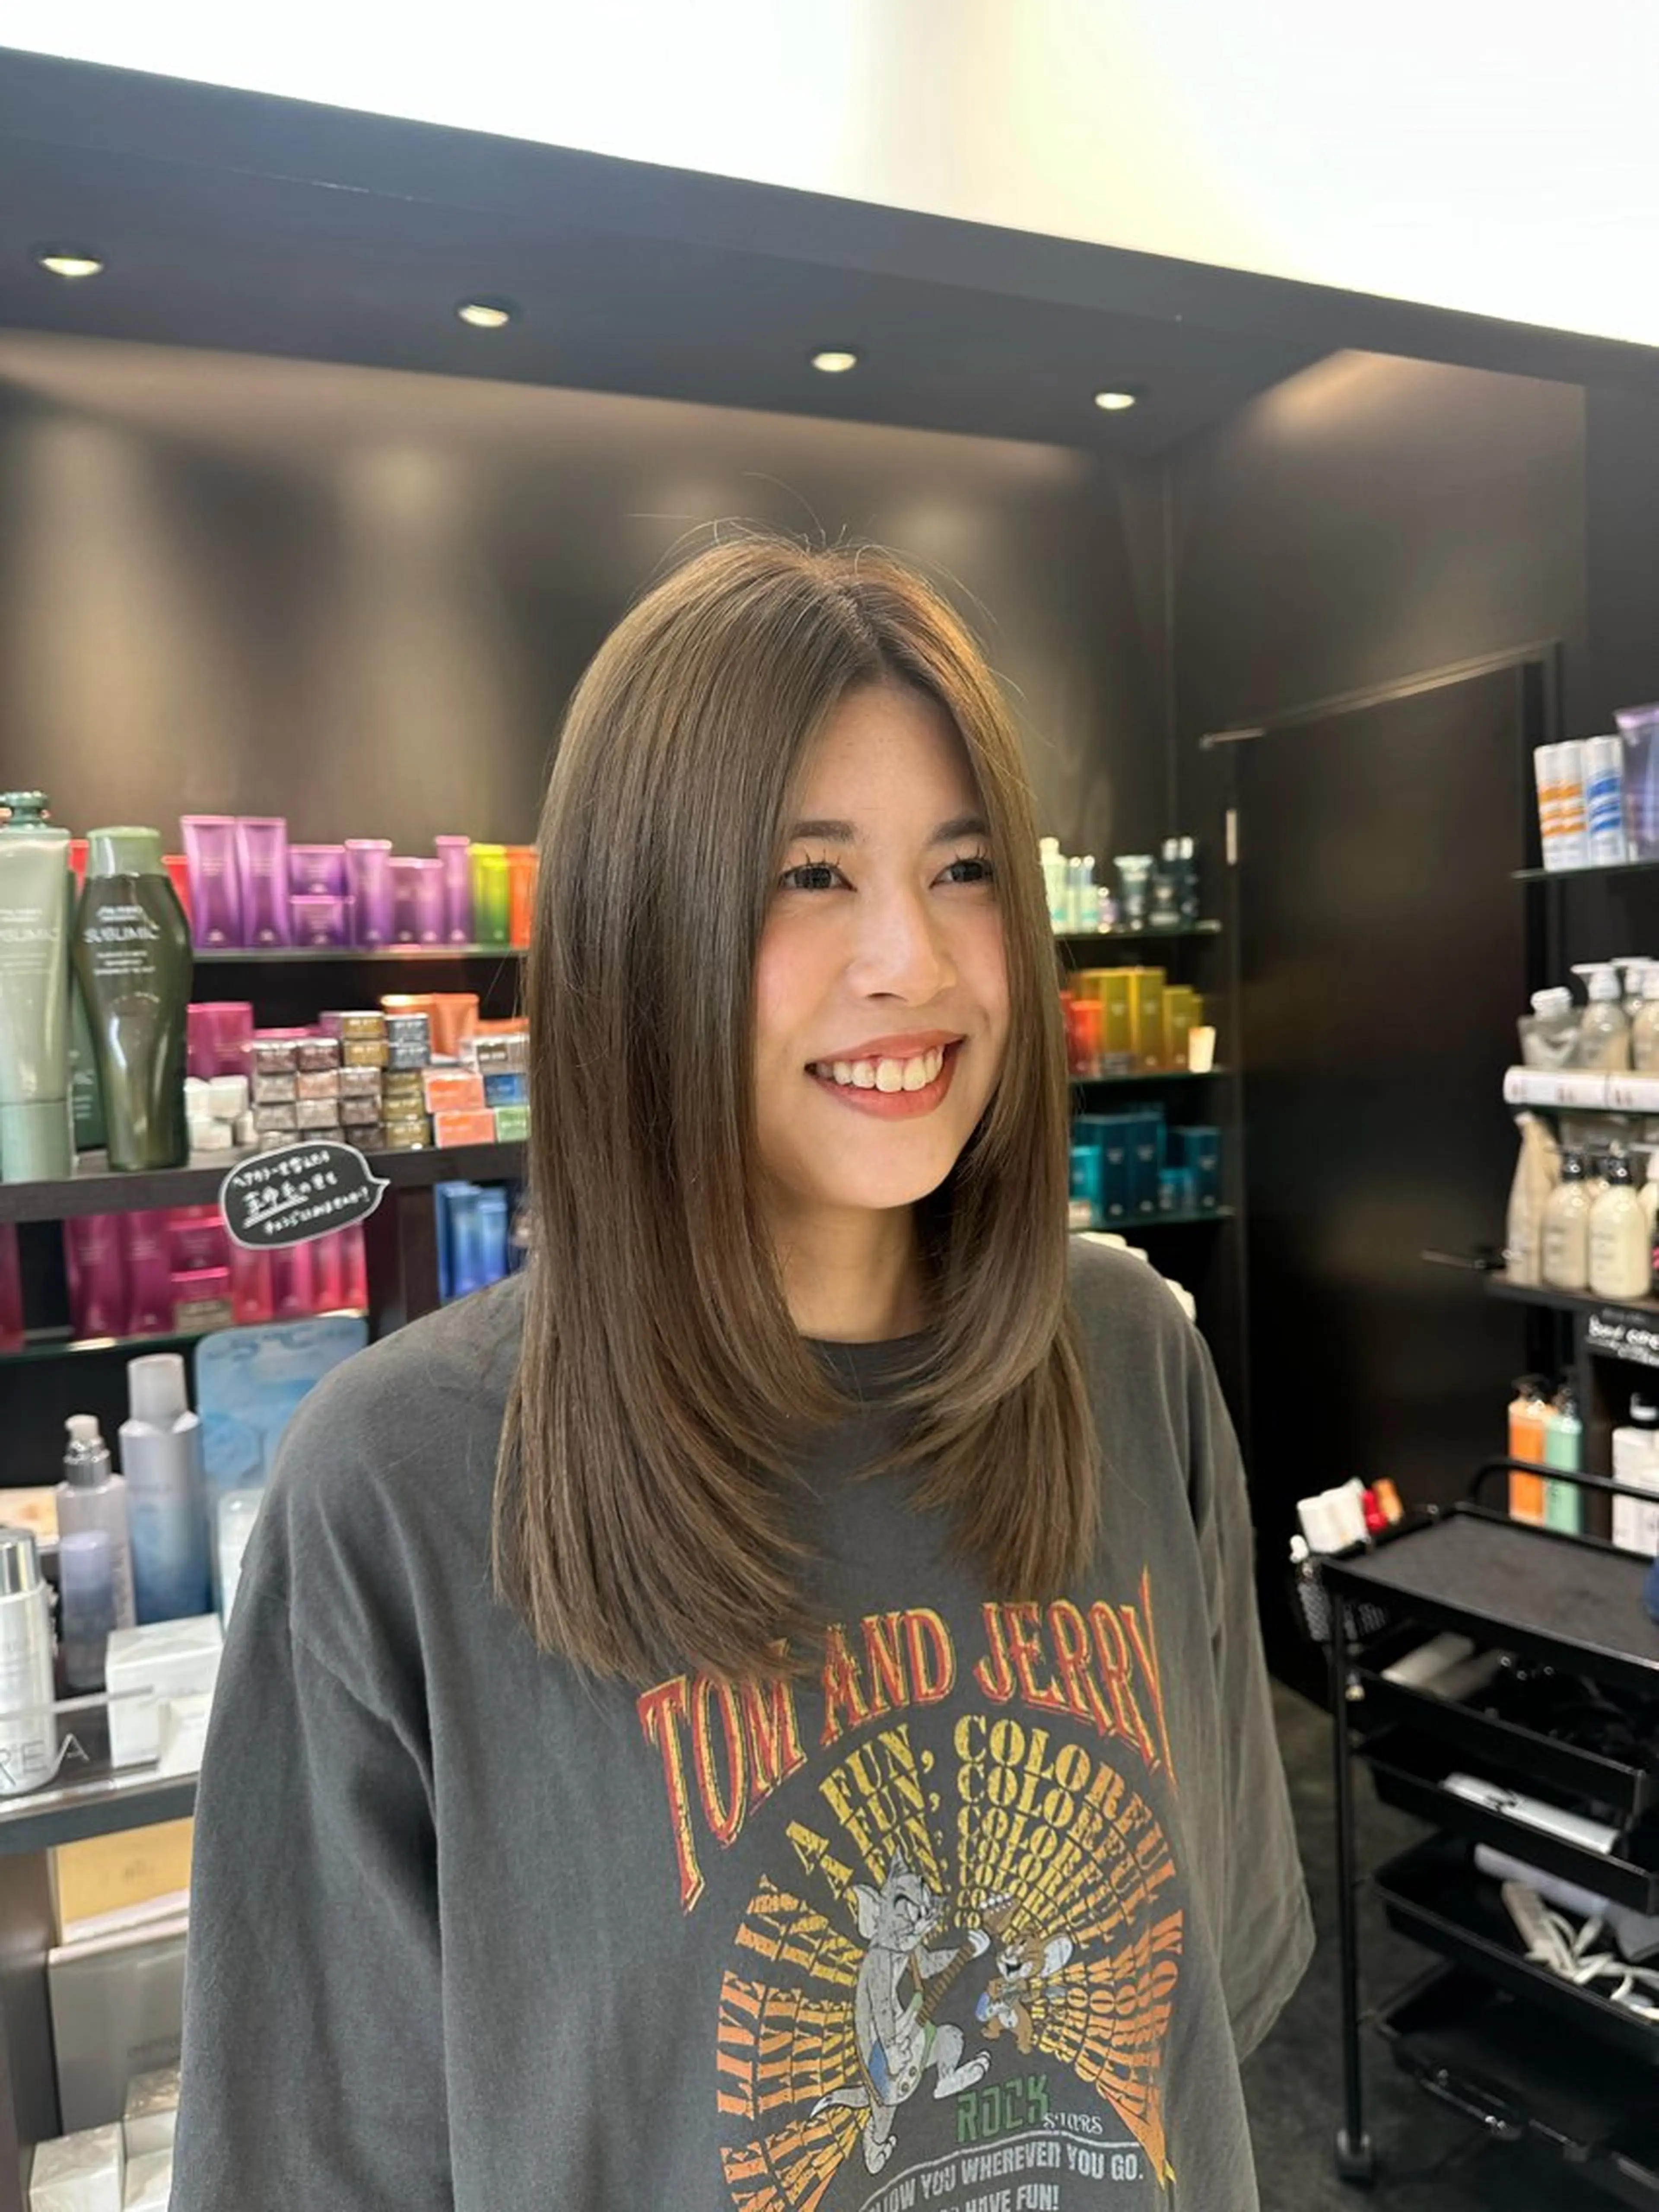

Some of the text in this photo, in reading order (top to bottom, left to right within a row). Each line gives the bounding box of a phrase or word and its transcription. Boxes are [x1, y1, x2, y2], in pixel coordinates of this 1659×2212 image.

[637, 1563, 1179, 1915] TOM AND JERRY
[786, 1820, 830, 1875] A
[819, 1723, 934, 1826] FUN,
[953, 1714, 1176, 1904] COLORFUL
[820, 1855, 854, 1900] A
[957, 2074, 1049, 2143] ROCK
[920, 2164, 956, 2199] YOU
[961, 2141, 1060, 2185] WHEREVER
[1066, 2143, 1105, 2180] YOU
[1111, 2153, 1144, 2181] GO.
[1016, 2183, 1059, 2211] FUN!
